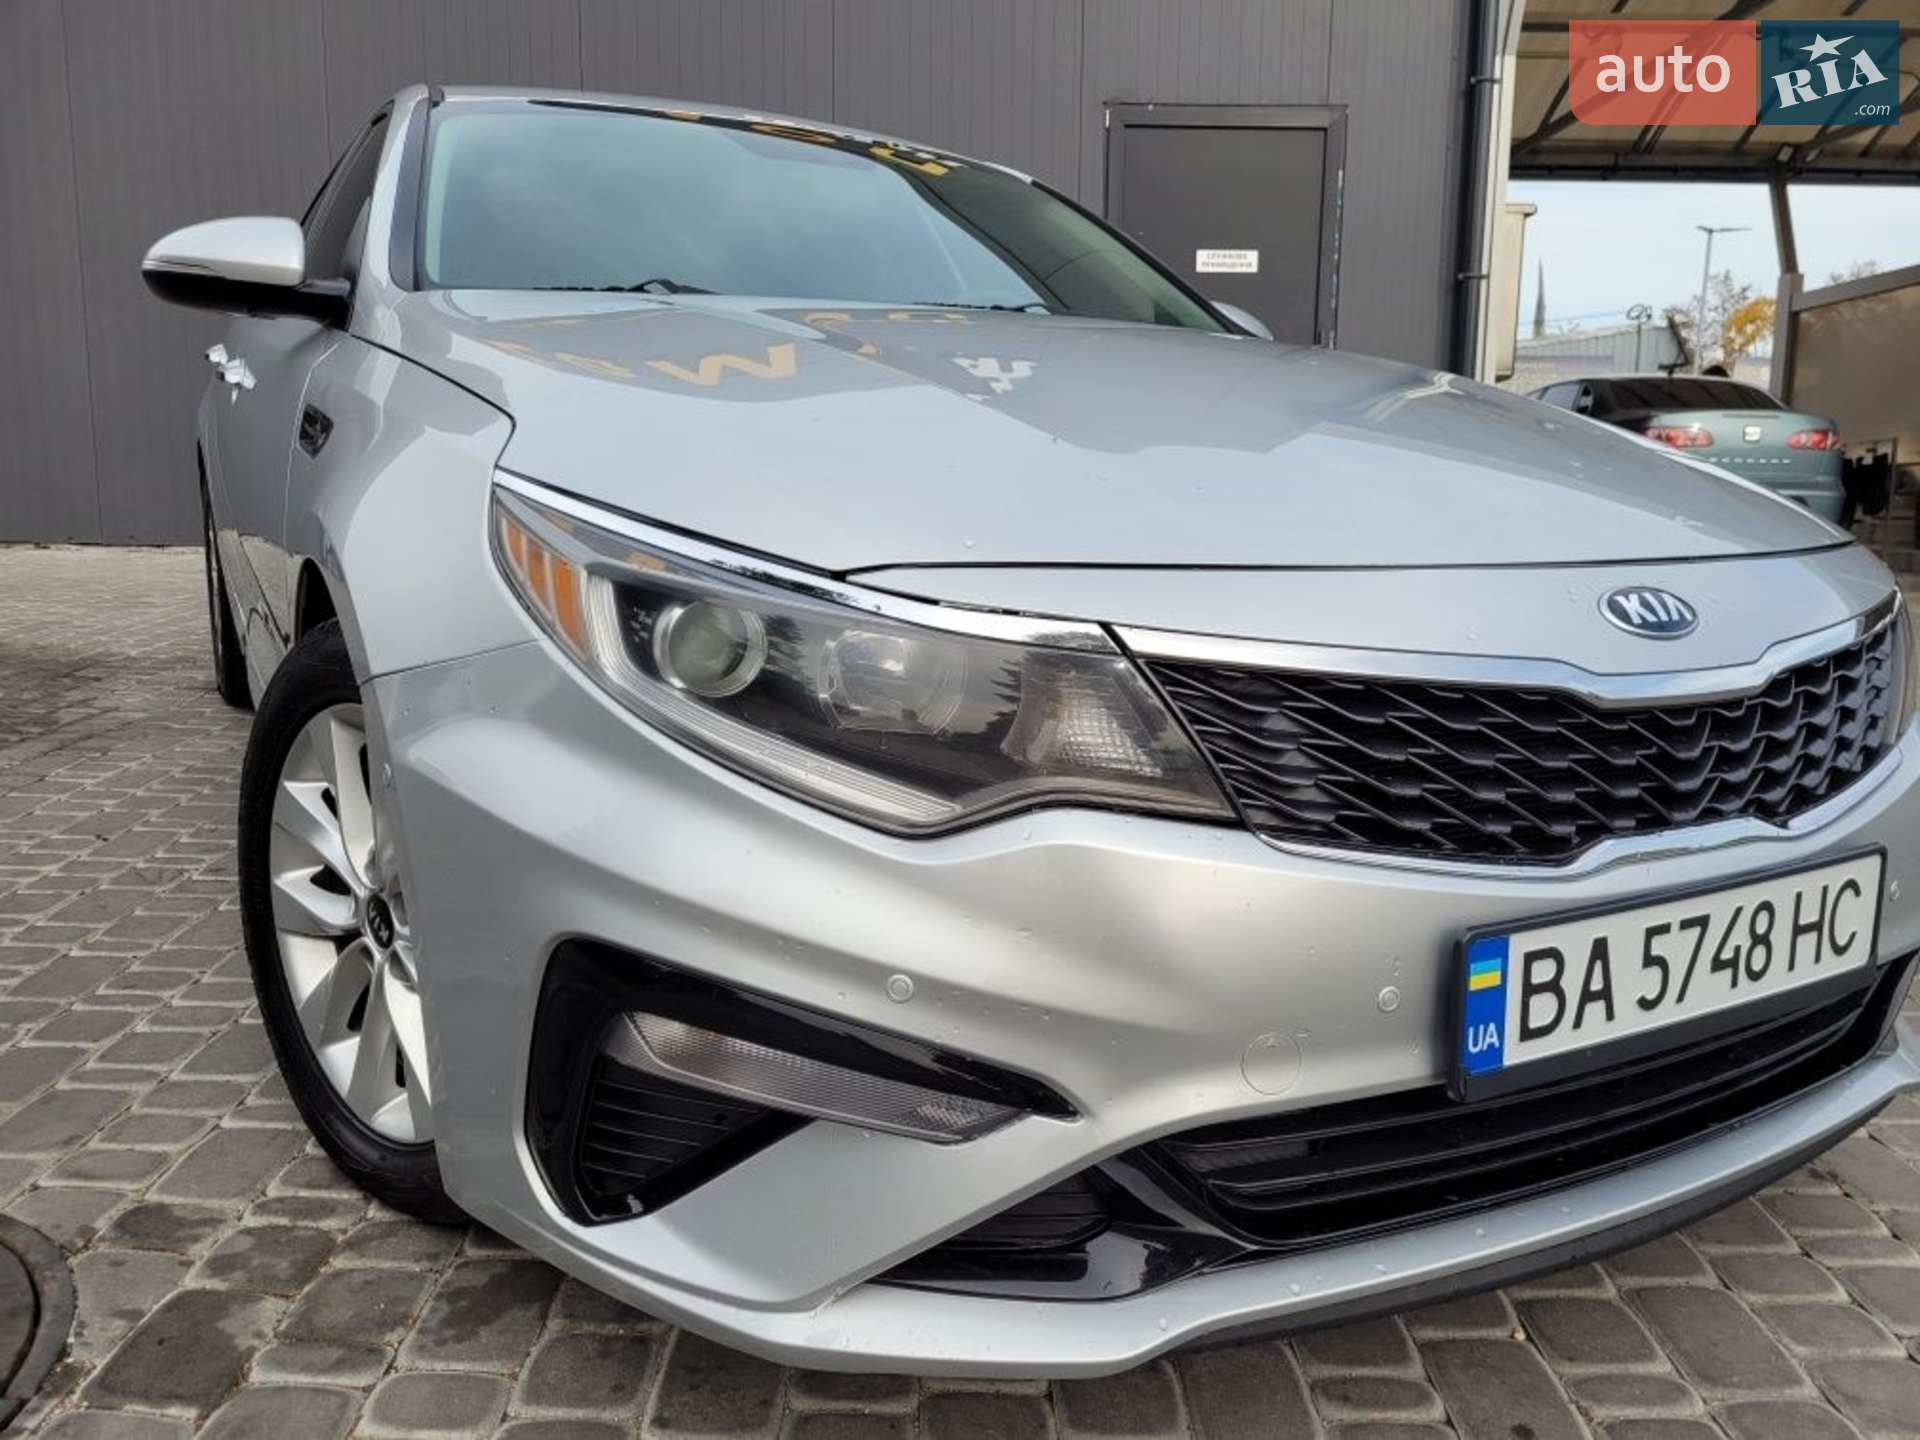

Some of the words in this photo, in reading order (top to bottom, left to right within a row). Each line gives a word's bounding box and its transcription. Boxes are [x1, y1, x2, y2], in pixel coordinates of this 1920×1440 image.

[1613, 591, 1693, 625] KIA
[1519, 936, 1615, 1043] BA
[1636, 900, 1776, 1012] 5748
[1787, 878, 1862, 972] HC
[1467, 1022, 1500, 1054] UA
